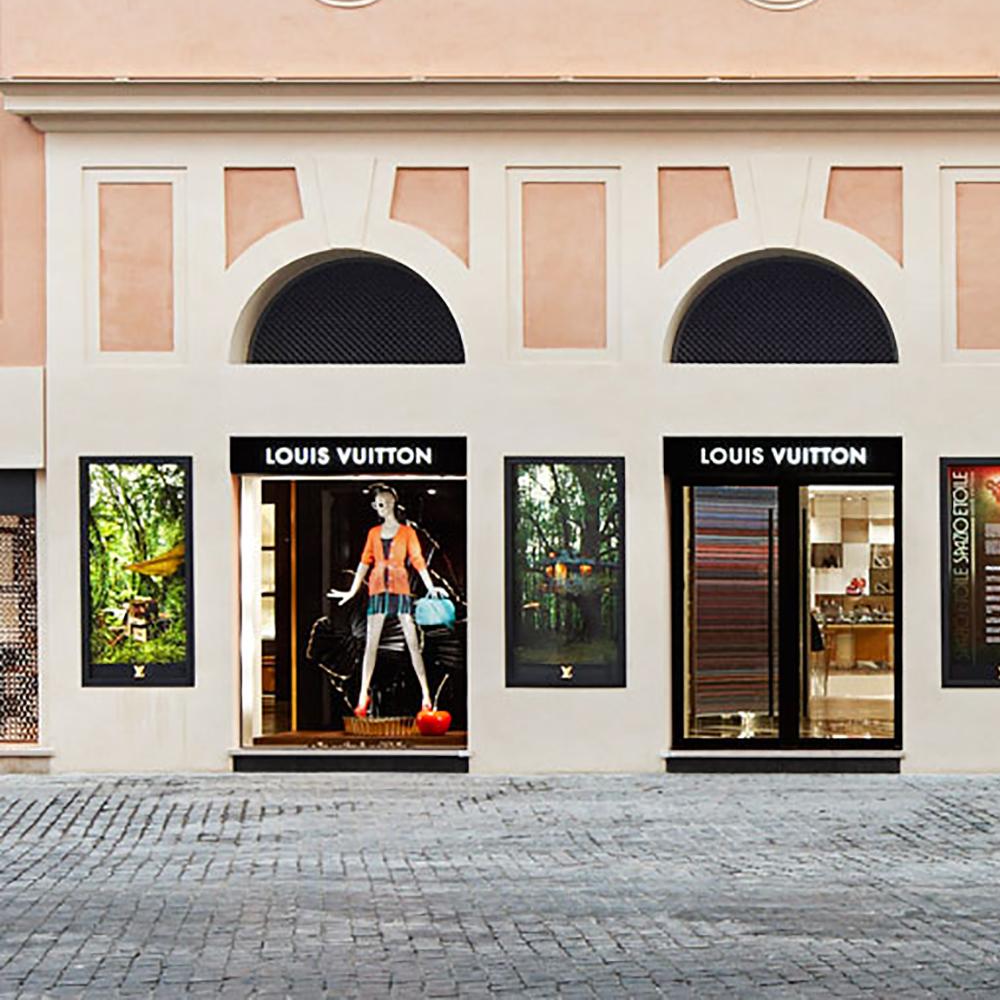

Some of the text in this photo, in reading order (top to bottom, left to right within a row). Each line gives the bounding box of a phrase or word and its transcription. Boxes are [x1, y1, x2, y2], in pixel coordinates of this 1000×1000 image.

[265, 446, 432, 466] LOUIS VUITTON
[700, 446, 867, 466] LOUIS VUITTON
[952, 471, 969, 516] ETOILE
